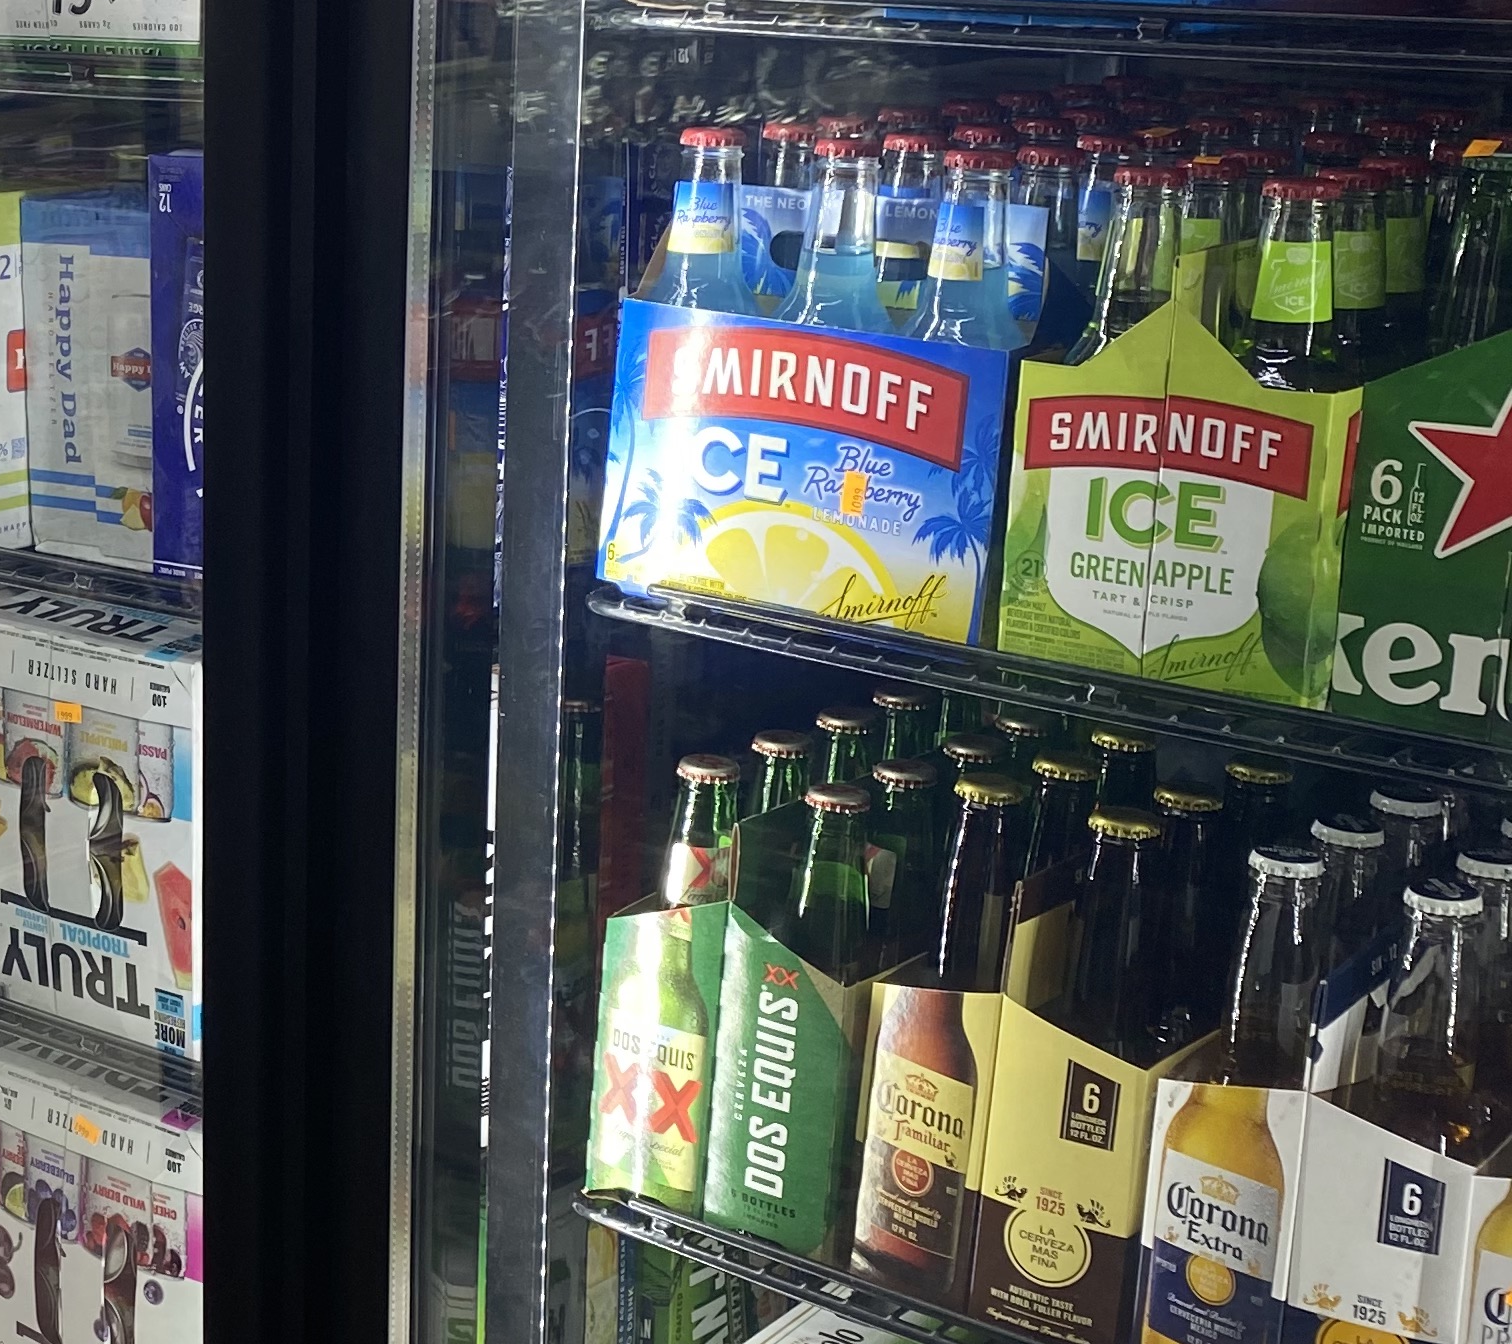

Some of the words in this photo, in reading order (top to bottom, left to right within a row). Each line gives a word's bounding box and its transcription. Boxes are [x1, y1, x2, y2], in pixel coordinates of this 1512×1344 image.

[55, 254, 76, 383] Happy
[670, 344, 935, 433] SMIRNOFF
[60, 392, 82, 465] Dad
[1050, 411, 1282, 470] SMIRNOFF
[839, 446, 891, 477] Blue
[851, 477, 864, 515] 1099
[1372, 459, 1403, 506] 6
[810, 505, 901, 537] LEMONADE
[1085, 478, 1226, 554] ICE
[1363, 504, 1403, 525] PACK
[1361, 522, 1425, 542] IMPORTED
[1070, 552, 1145, 587] GREEN
[1152, 560, 1234, 596] APPLE
[1092, 589, 1128, 605] TART
[1132, 597, 1141, 606] &
[1150, 595, 1194, 609] CRISP
[28, 659, 76, 685] SELTZER
[85, 671, 117, 694] HARD
[59, 923, 130, 957] TROPICAL
[1, 926, 150, 1018] TRULY
[750, 991, 800, 1115] EQUIS
[876, 1080, 966, 1139] Corona
[1082, 1083, 1100, 1115] 6
[893, 1119, 952, 1154] Familiar
[30, 1156, 75, 1185] BLUEBERRY
[744, 1115, 788, 1198] DOS
[741, 1192, 797, 1220] BOTTLES
[1035, 1196, 1066, 1217] 1925
[1165, 1180, 1271, 1248] Corona
[1403, 1181, 1423, 1217] 6
[1018, 1229, 1075, 1255] CERVEZA
[1039, 1226, 1057, 1238] LA
[1187, 1220, 1244, 1262] Extra
[1030, 1255, 1058, 1271] FINA
[1031, 1244, 1060, 1260] MAS
[1351, 1304, 1387, 1327] 1925
